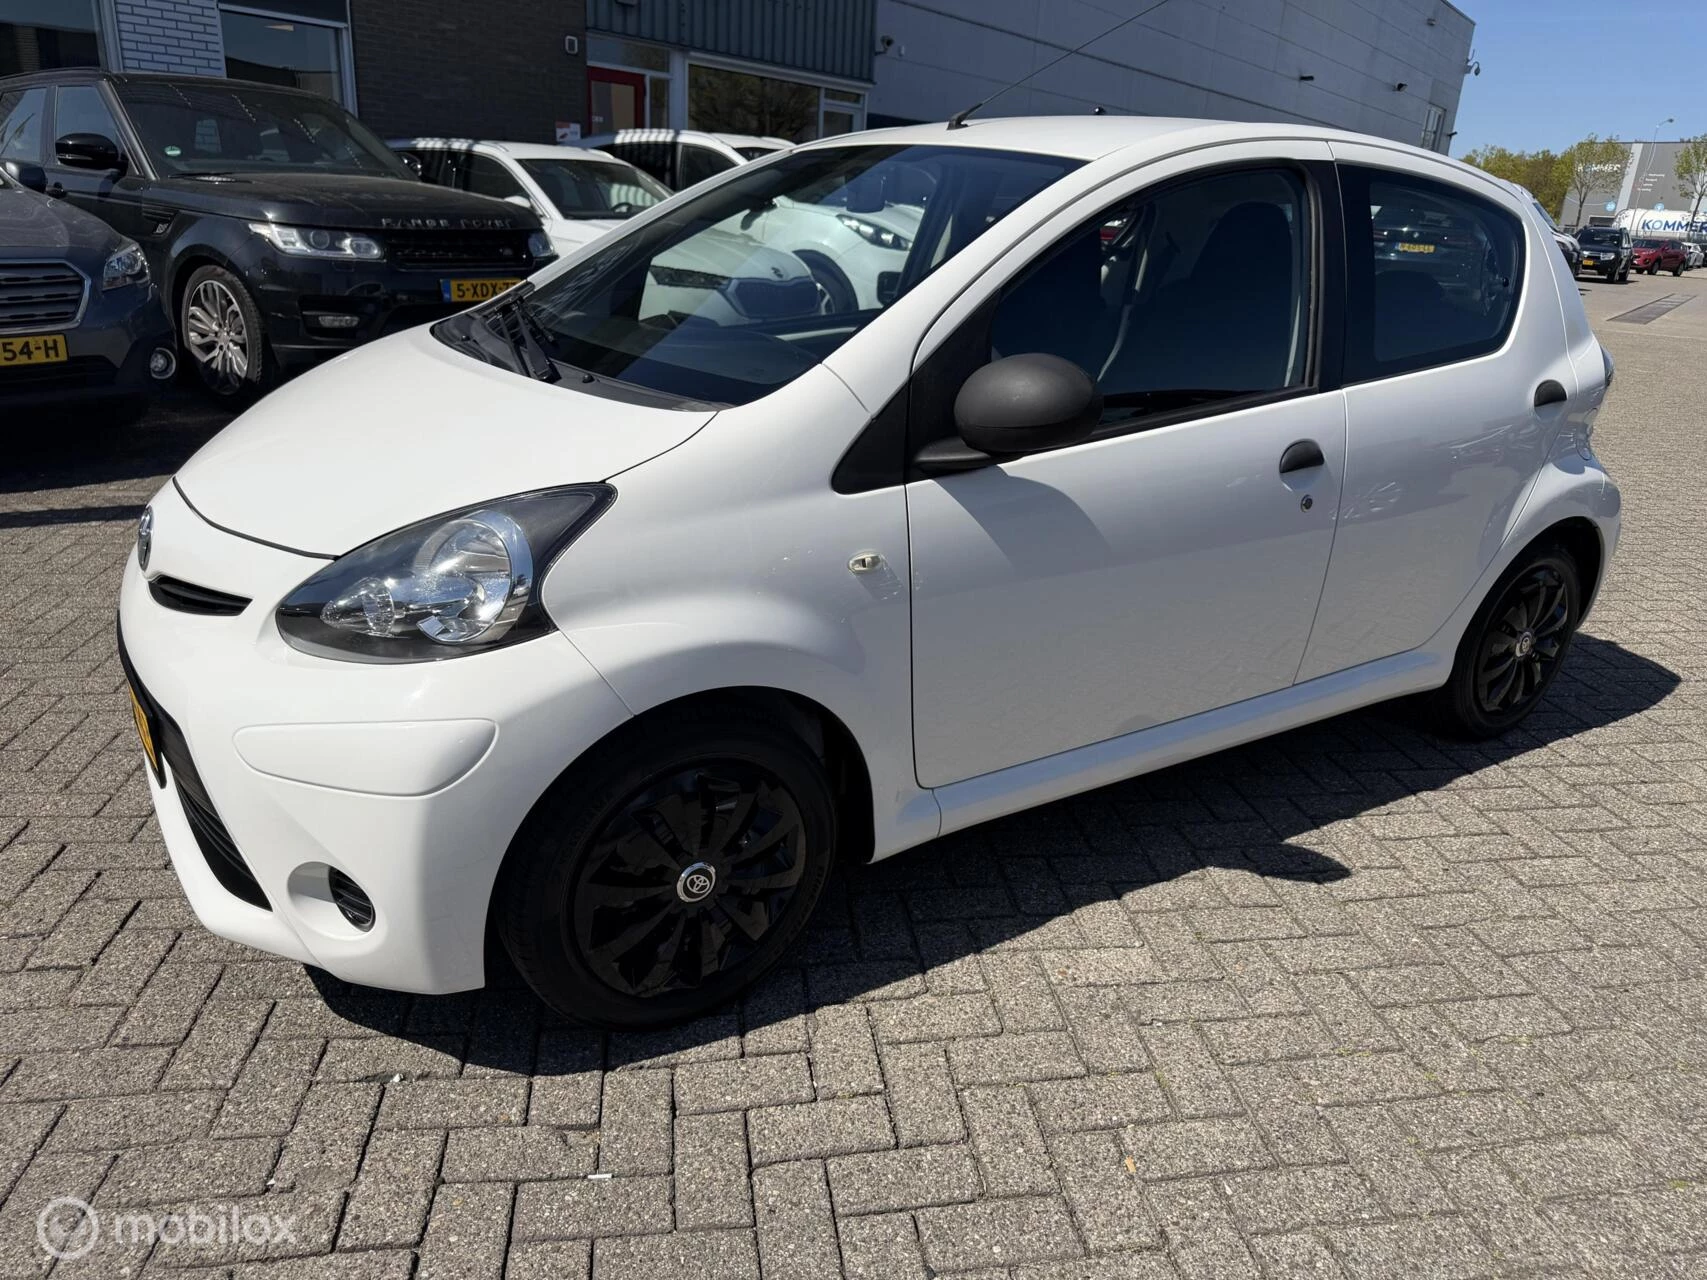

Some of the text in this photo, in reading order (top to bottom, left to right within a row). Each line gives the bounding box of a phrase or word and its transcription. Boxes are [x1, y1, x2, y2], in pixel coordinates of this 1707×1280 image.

[381, 218, 512, 229] RANGE ROVER
[1641, 219, 1707, 233] KOMMER
[1, 338, 60, 361] 54-H
